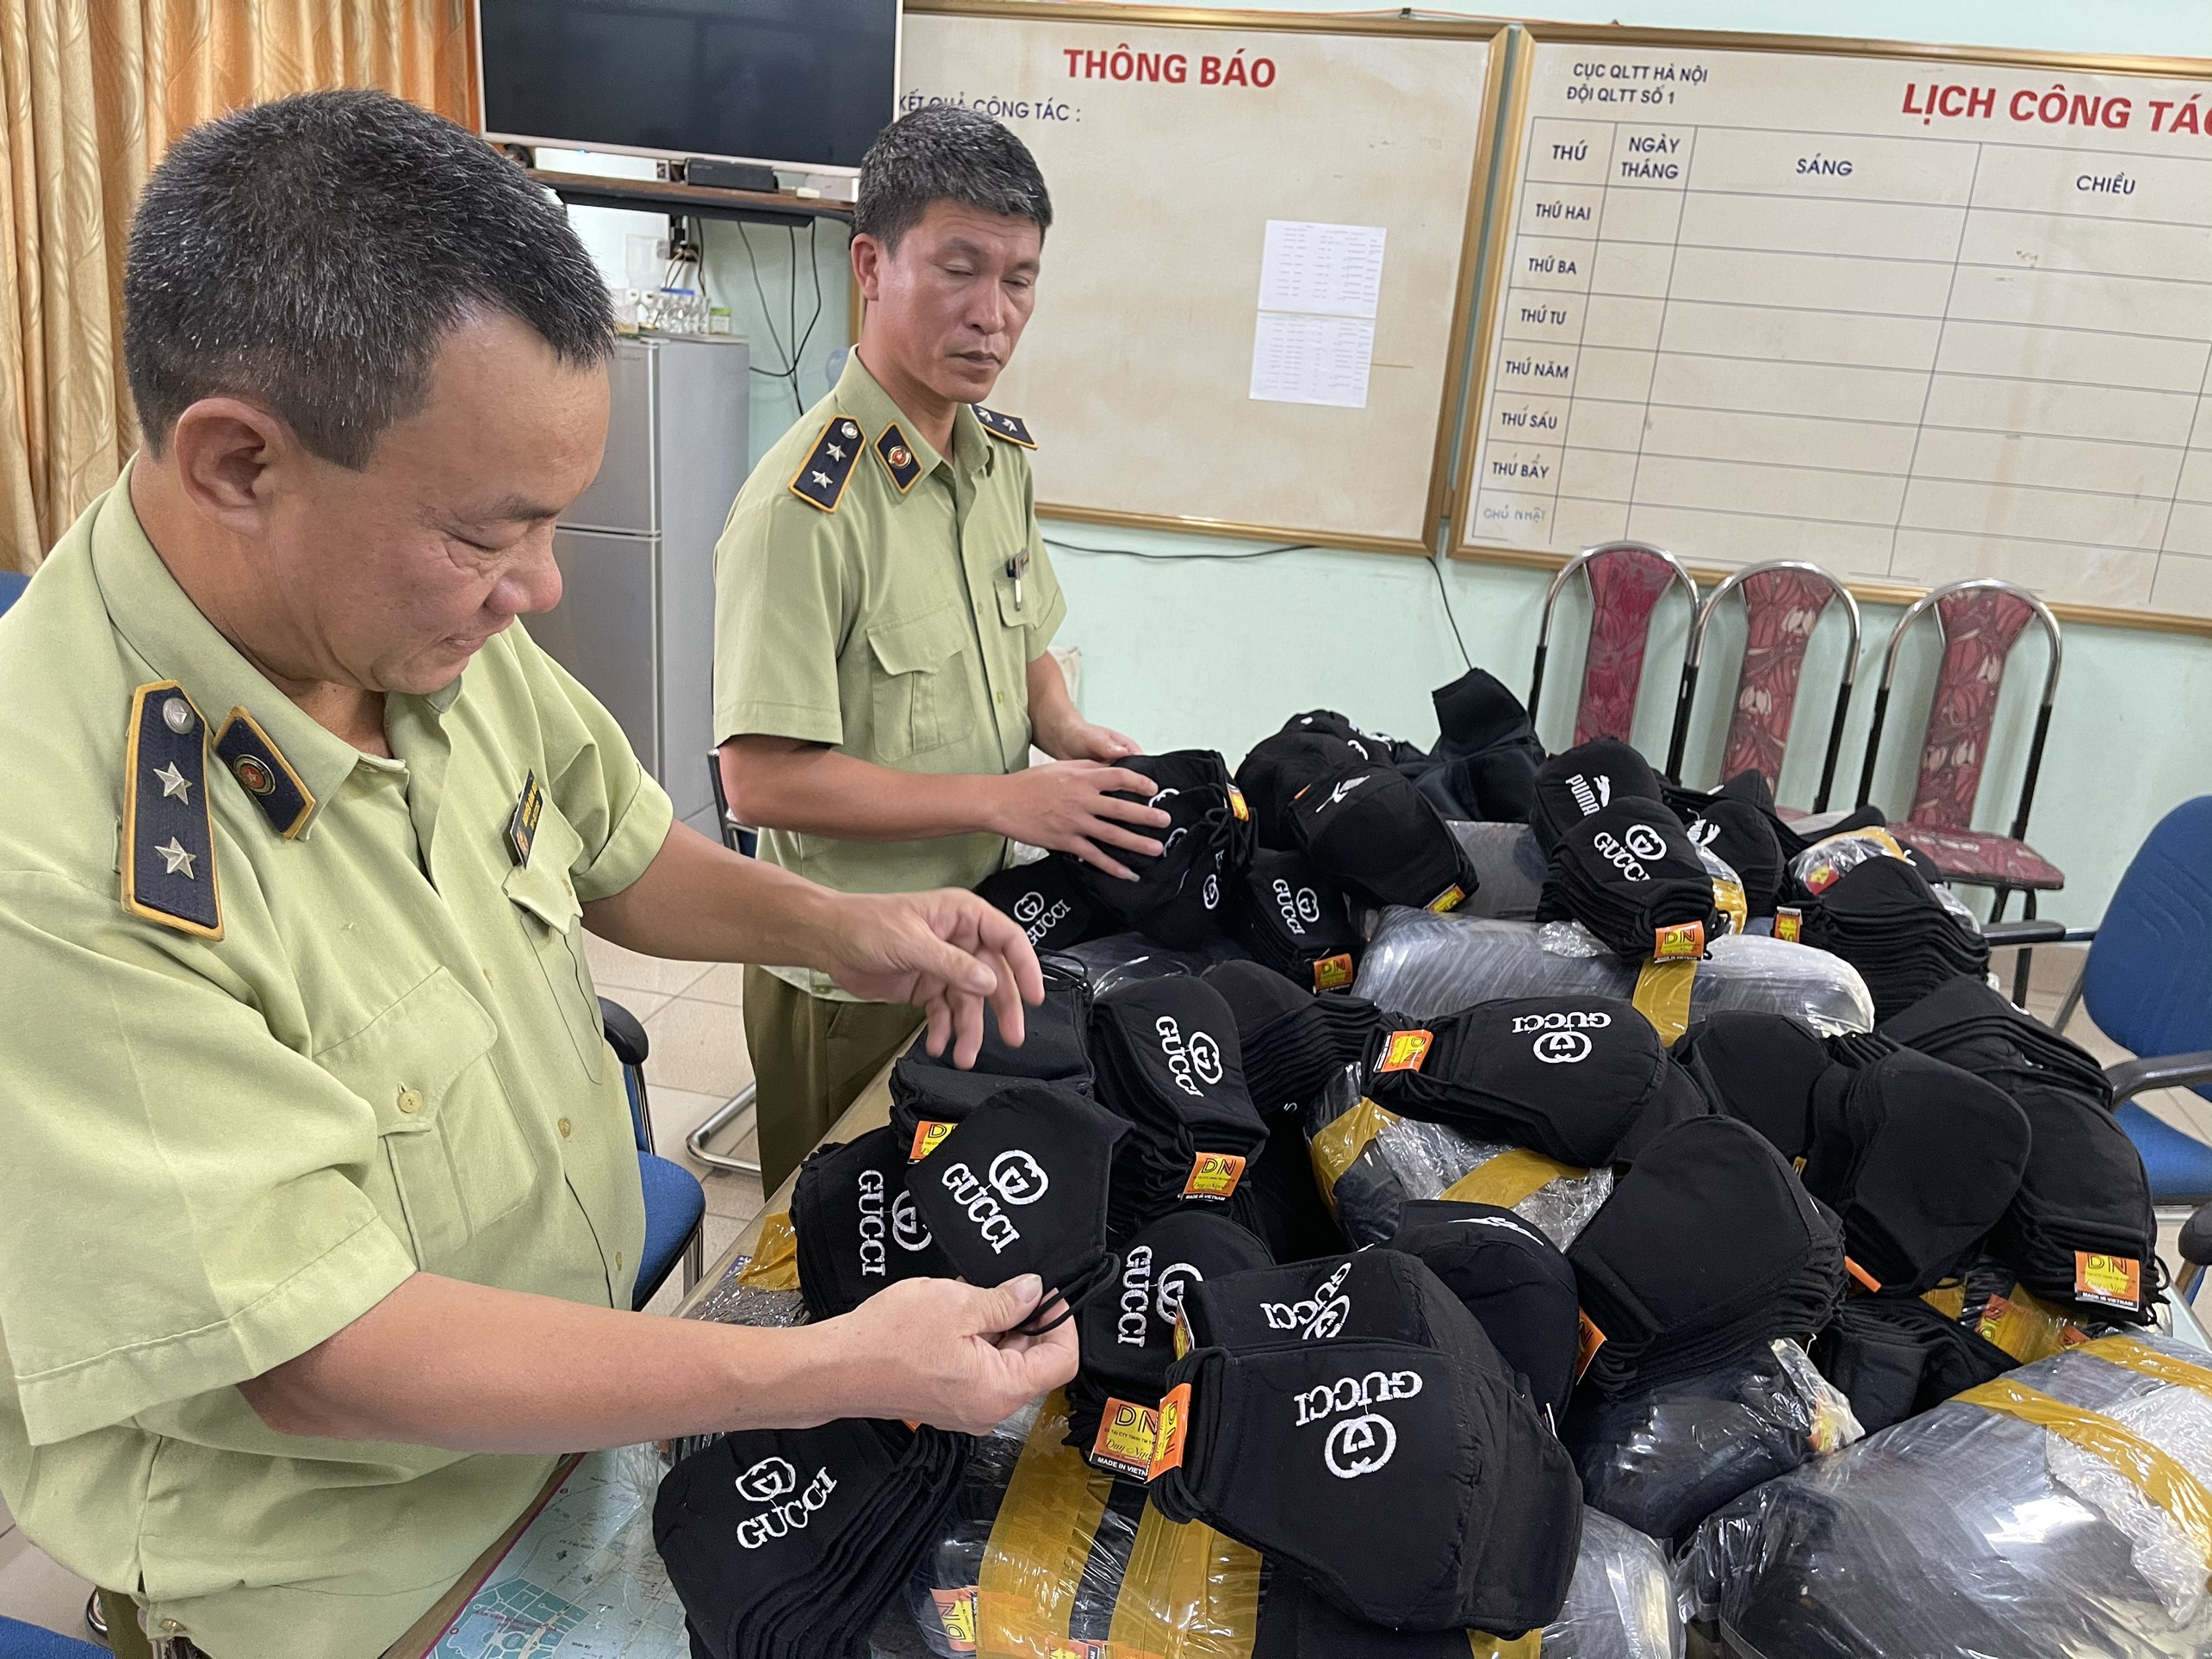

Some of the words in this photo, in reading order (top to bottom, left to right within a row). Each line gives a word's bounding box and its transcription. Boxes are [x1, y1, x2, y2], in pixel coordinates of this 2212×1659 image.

[1064, 43, 1187, 84] THÔNG
[1200, 48, 1277, 88] BÁO
[1574, 63, 1606, 80] CỤC
[1610, 65, 1650, 80] QLTT
[1654, 63, 1675, 81] HÀ
[1680, 65, 1708, 85] NỘI
[1567, 84, 1594, 103] ĐỘI
[1597, 88, 1637, 104] QLTT
[1641, 84, 1663, 104] SỐ
[1668, 91, 1675, 104] 1
[1902, 83, 1996, 125] LỊCH
[2009, 84, 2132, 129] CÔNG
[973, 96, 1029, 118] CÔNG
[1035, 97, 1070, 121] TÁC
[1552, 140, 1588, 161] THỨ
[1628, 134, 1681, 154] NGÀY
[1620, 158, 1679, 179] THÁNG
[1796, 153, 1853, 177] SÁNG
[2076, 173, 2136, 196] CHIỀU
[1536, 201, 1563, 219] THỨ
[1565, 206, 1591, 221] HAI
[1528, 255, 1554, 272] THỨ
[1557, 261, 1576, 275] BA
[1521, 304, 1547, 324] THỨ
[1506, 357, 1532, 376] THỨ
[1534, 361, 1569, 379] NĂM
[1501, 405, 1529, 426] THỨ
[1530, 411, 1557, 430] SÁU
[1493, 452, 1518, 476] THỨ
[1564, 774, 1601, 817] PUMA
[1594, 831, 1651, 883] GUCCI
[1272, 878, 1307, 935] GUCCI
[1664, 928, 1695, 944] DN
[1320, 958, 1345, 974] DN
[1512, 1010, 1612, 1035] GUCCI
[1155, 1016, 1204, 1097] GUCCI
[1201, 1158, 1237, 1177] DN
[941, 1163, 1021, 1255] GUCCI
[858, 1170, 886, 1277] GUCCI
[2087, 1253, 2128, 1276] DN
[1117, 1245, 1153, 1348] GUCCI
[1259, 1262, 1351, 1330] GUCCI
[1294, 1370, 1423, 1427] GUCCI
[1115, 1404, 1157, 1435] DN
[1097, 1457, 1118, 1468] MADE
[1126, 1466, 1148, 1476] VIETN
[736, 1466, 838, 1550] GUCCI
[935, 1601, 966, 1641] DN
